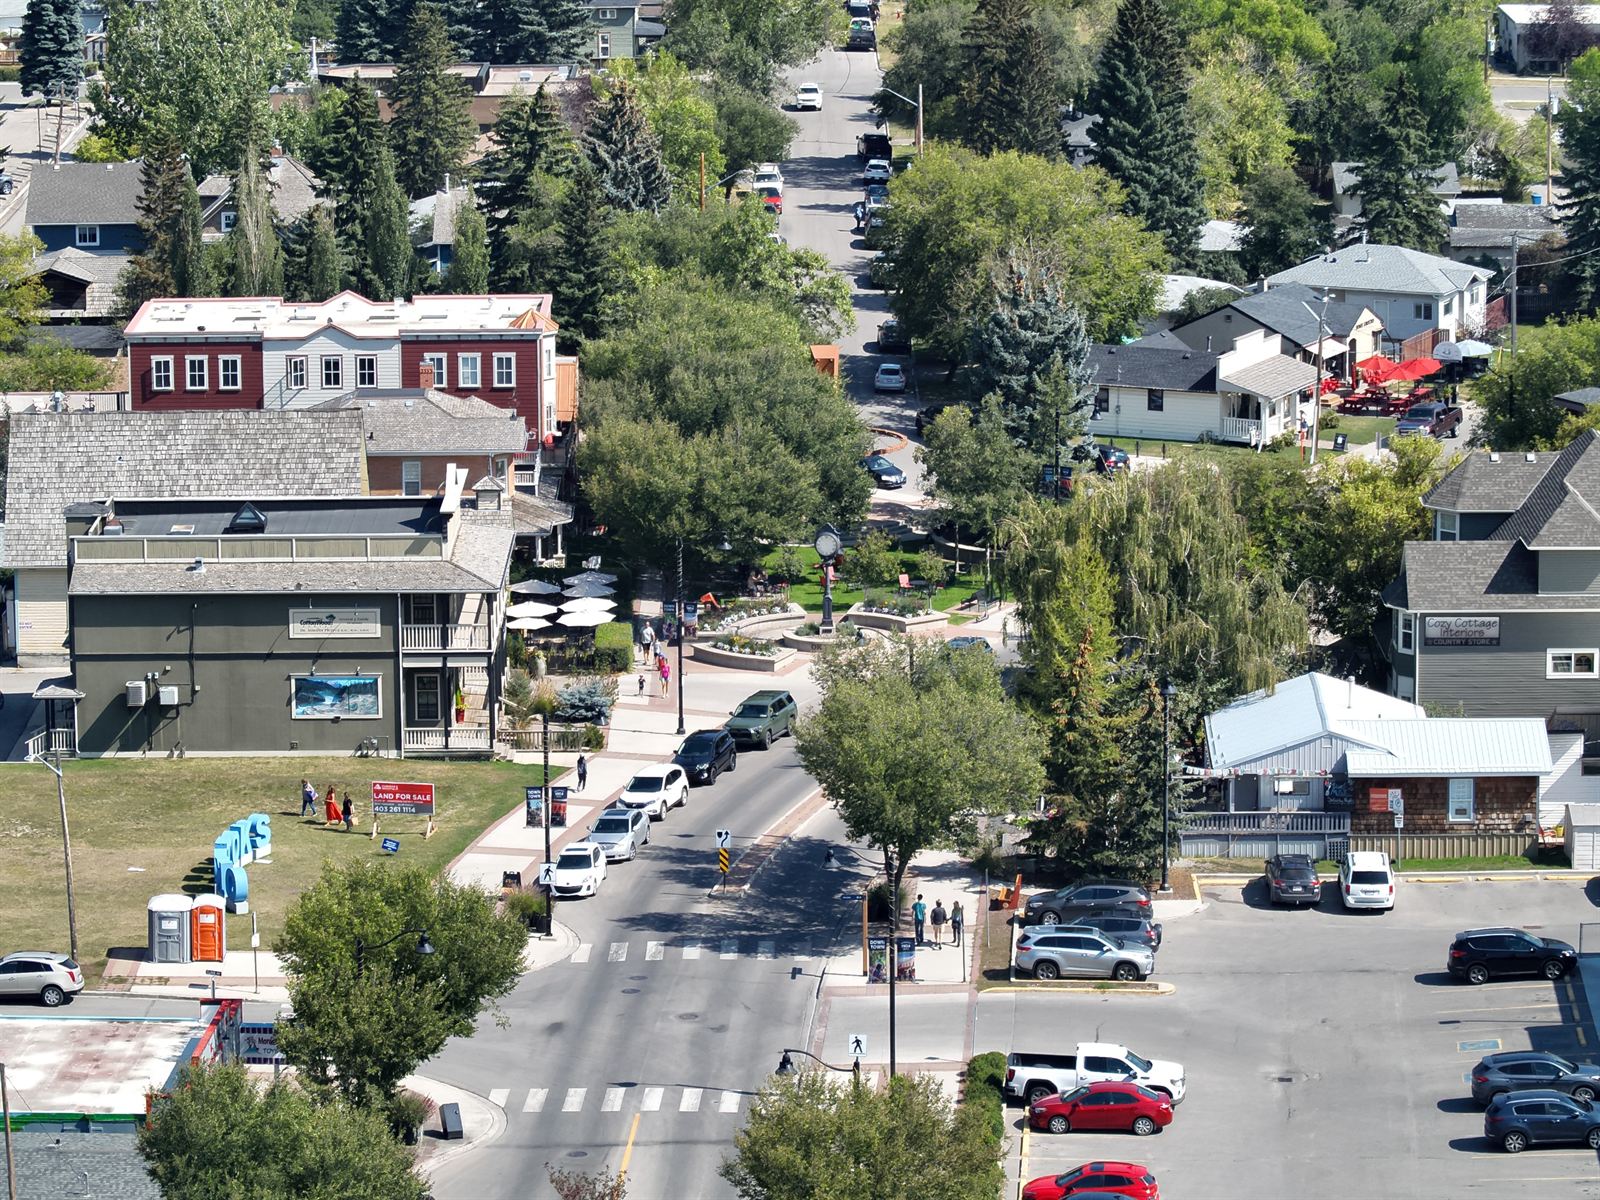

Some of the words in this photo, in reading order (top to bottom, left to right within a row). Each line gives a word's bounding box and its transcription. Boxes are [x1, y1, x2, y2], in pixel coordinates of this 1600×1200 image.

[1427, 617, 1452, 629] Cozy
[1454, 617, 1498, 630] Cottage
[1440, 628, 1485, 637] Interiors
